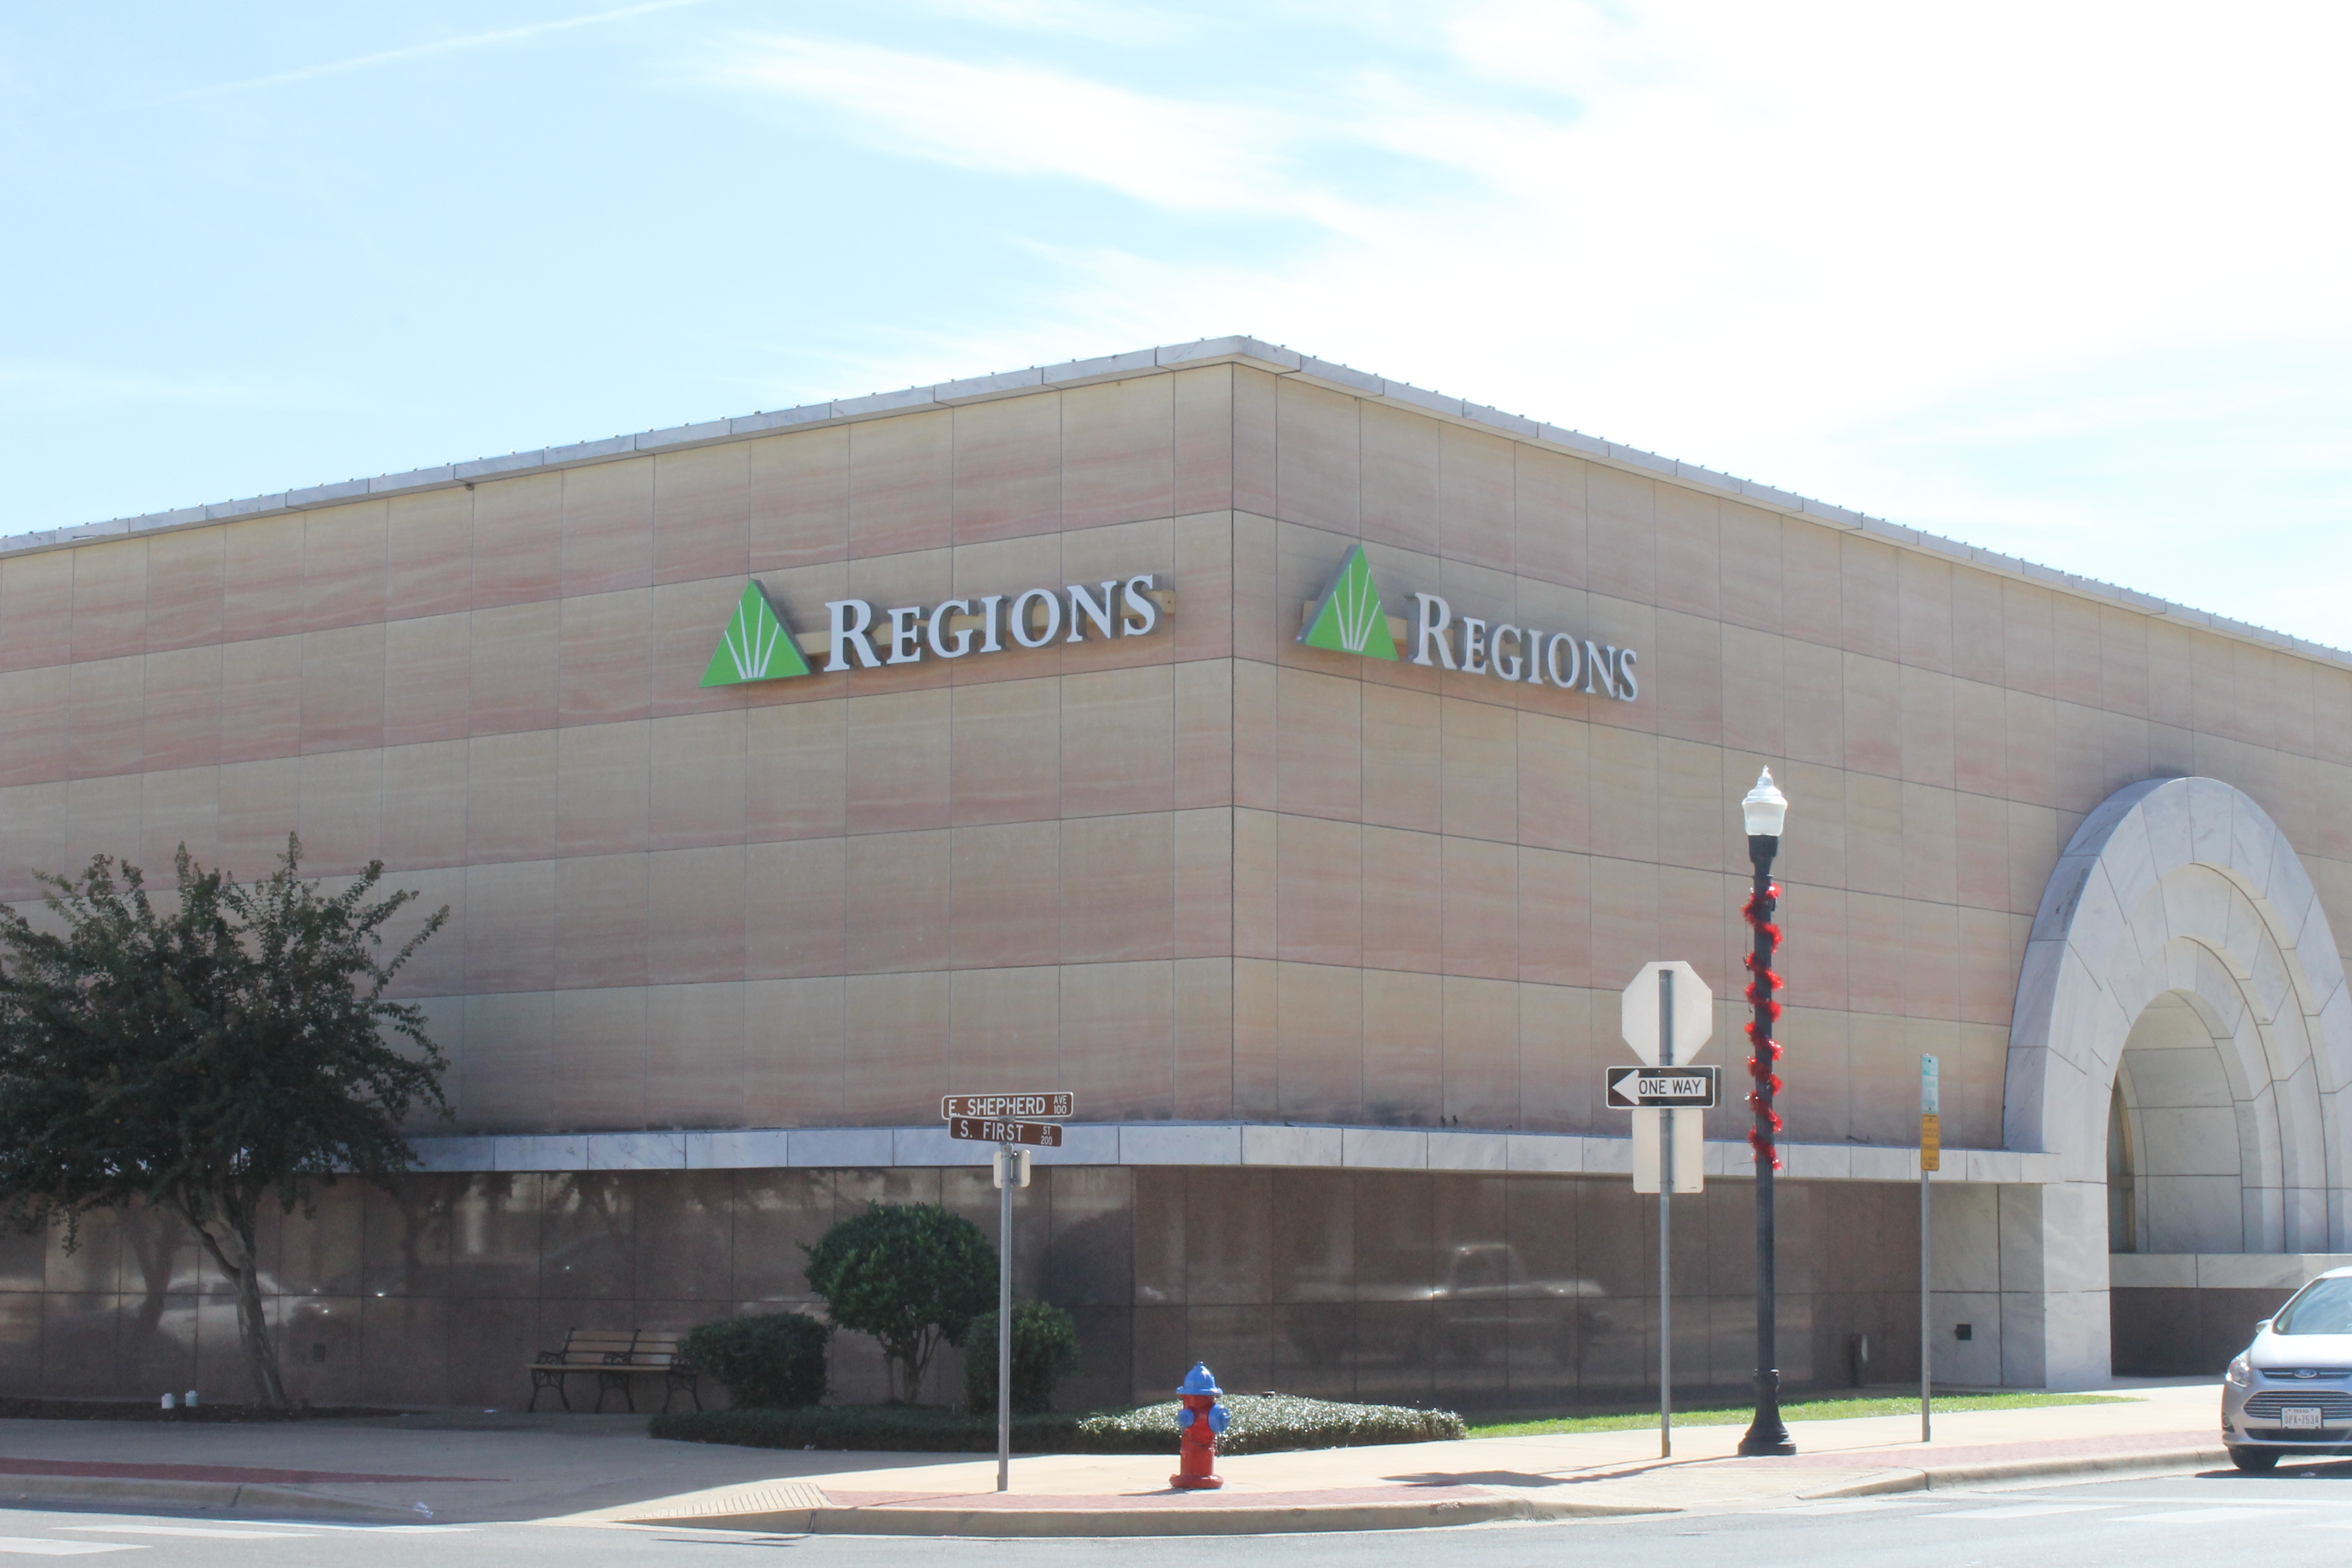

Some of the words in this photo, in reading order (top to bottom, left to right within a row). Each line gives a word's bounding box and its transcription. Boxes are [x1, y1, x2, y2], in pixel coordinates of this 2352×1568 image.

[824, 574, 1157, 672] REGIONS
[1411, 591, 1638, 703] REGIONS
[1638, 1080, 1667, 1095] ONE
[1672, 1079, 1702, 1095] WAY
[948, 1099, 961, 1117] E.
[967, 1096, 1046, 1116] SHEPHERD
[1053, 1095, 1067, 1104] AVE
[1053, 1105, 1067, 1114] 100
[960, 1119, 973, 1138] S.
[983, 1121, 1024, 1142] FIRST
[1042, 1125, 1052, 1135] ST
[1040, 1135, 1053, 1146] 200
